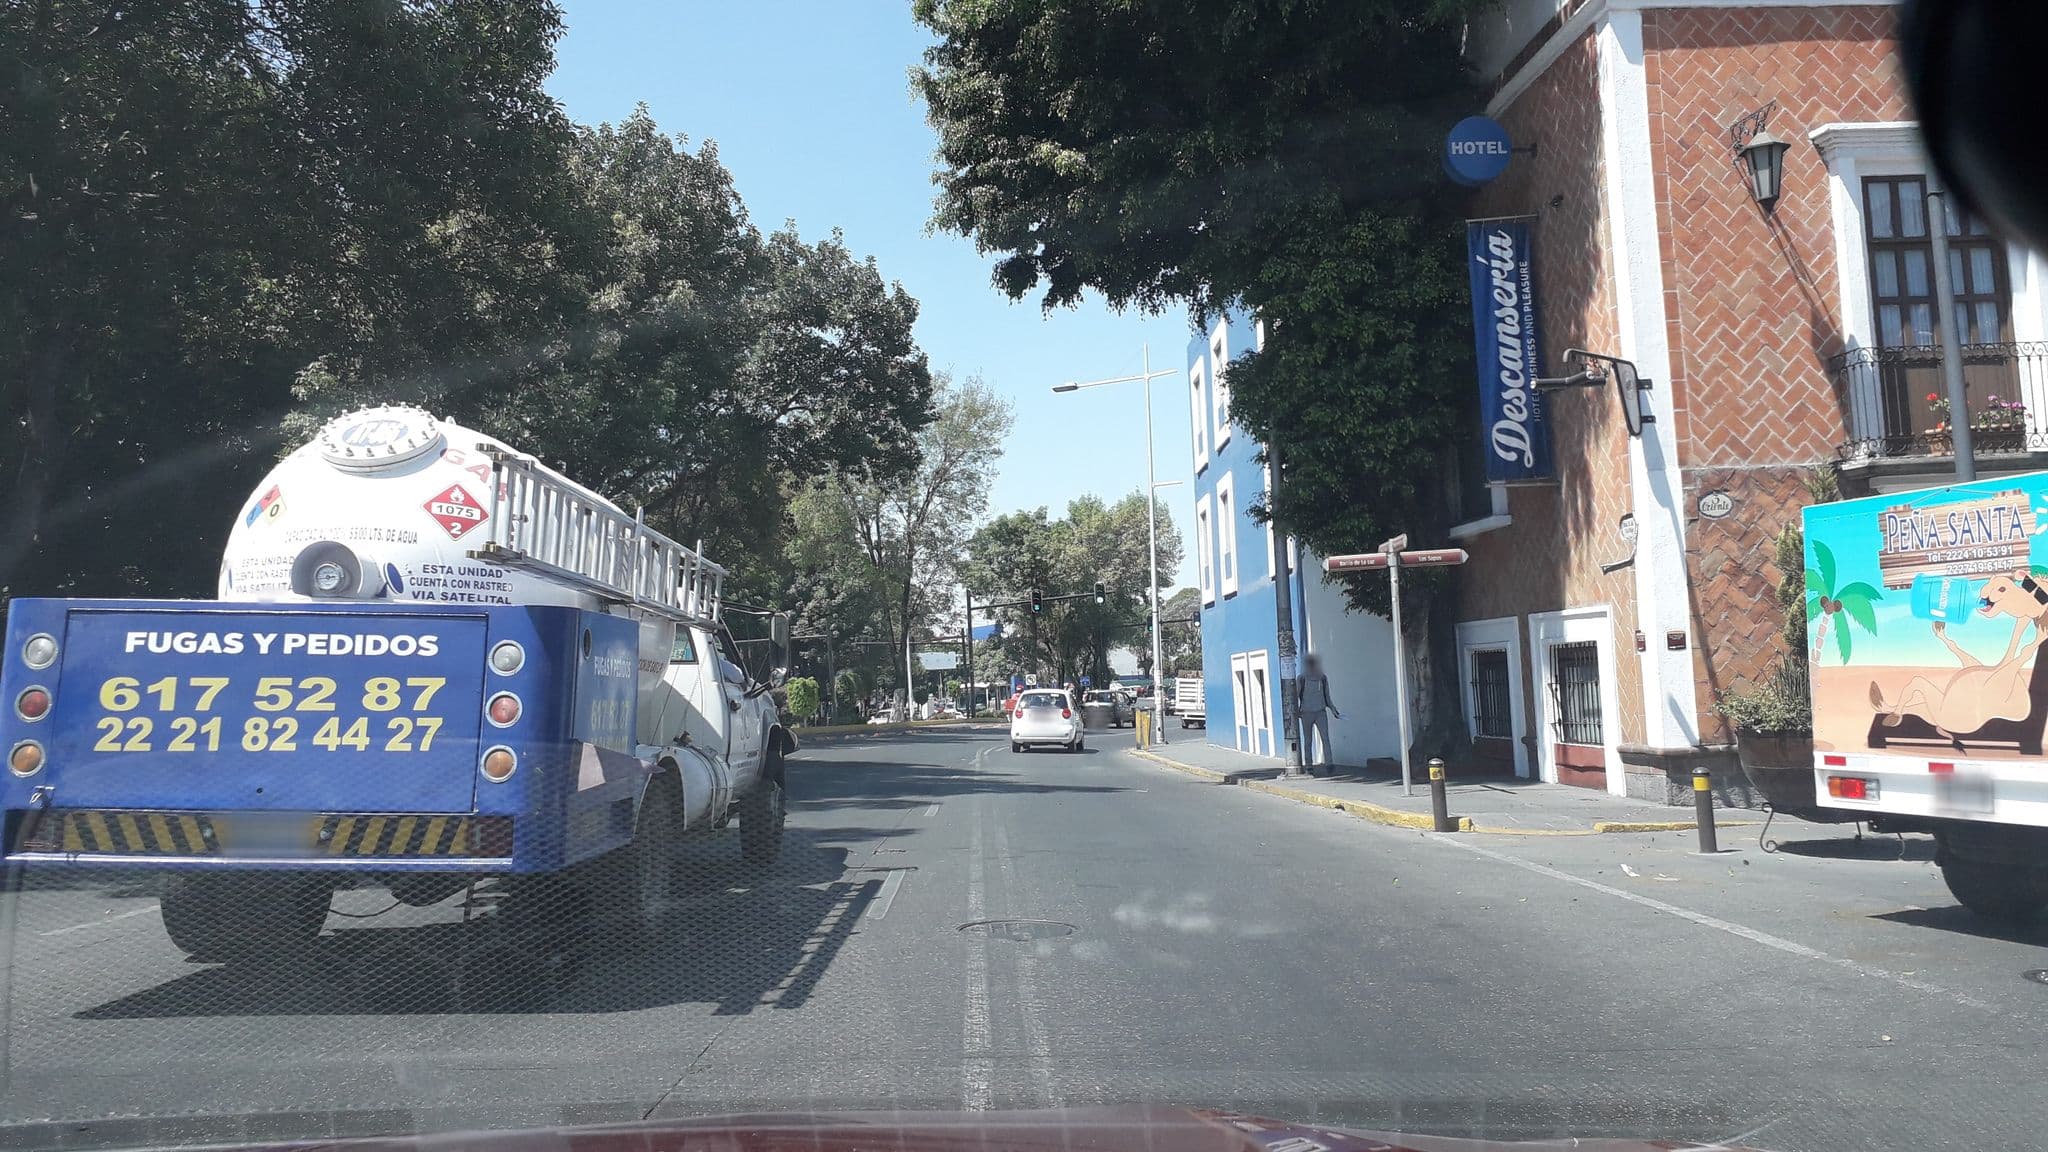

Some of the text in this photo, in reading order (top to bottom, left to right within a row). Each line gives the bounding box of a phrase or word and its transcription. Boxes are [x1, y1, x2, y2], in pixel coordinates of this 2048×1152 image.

[1451, 141, 1508, 155] HOTEL
[1519, 260, 1541, 422] HOTEL USINESS AND PLEASURE
[1476, 230, 1533, 468] Descansería
[270, 504, 280, 518] 0
[436, 504, 474, 518] 1075
[450, 522, 462, 535] 2
[1886, 503, 2026, 553] PEÑA SANTA
[386, 528, 396, 542] DE
[397, 530, 418, 544] AGUA
[1972, 548, 1983, 559] 10
[2001, 544, 2014, 556] 91
[261, 555, 295, 566] UNIDAD
[422, 564, 503, 578] ESTA UNIDAD
[409, 577, 513, 592] CUENTA CON RASTREO
[412, 590, 512, 604] VIA SATELITAL
[124, 631, 439, 657] FUGAS Y PEDIDOS
[99, 677, 446, 712] 617 52 87
[93, 716, 444, 752] 22 21 82 44 27
